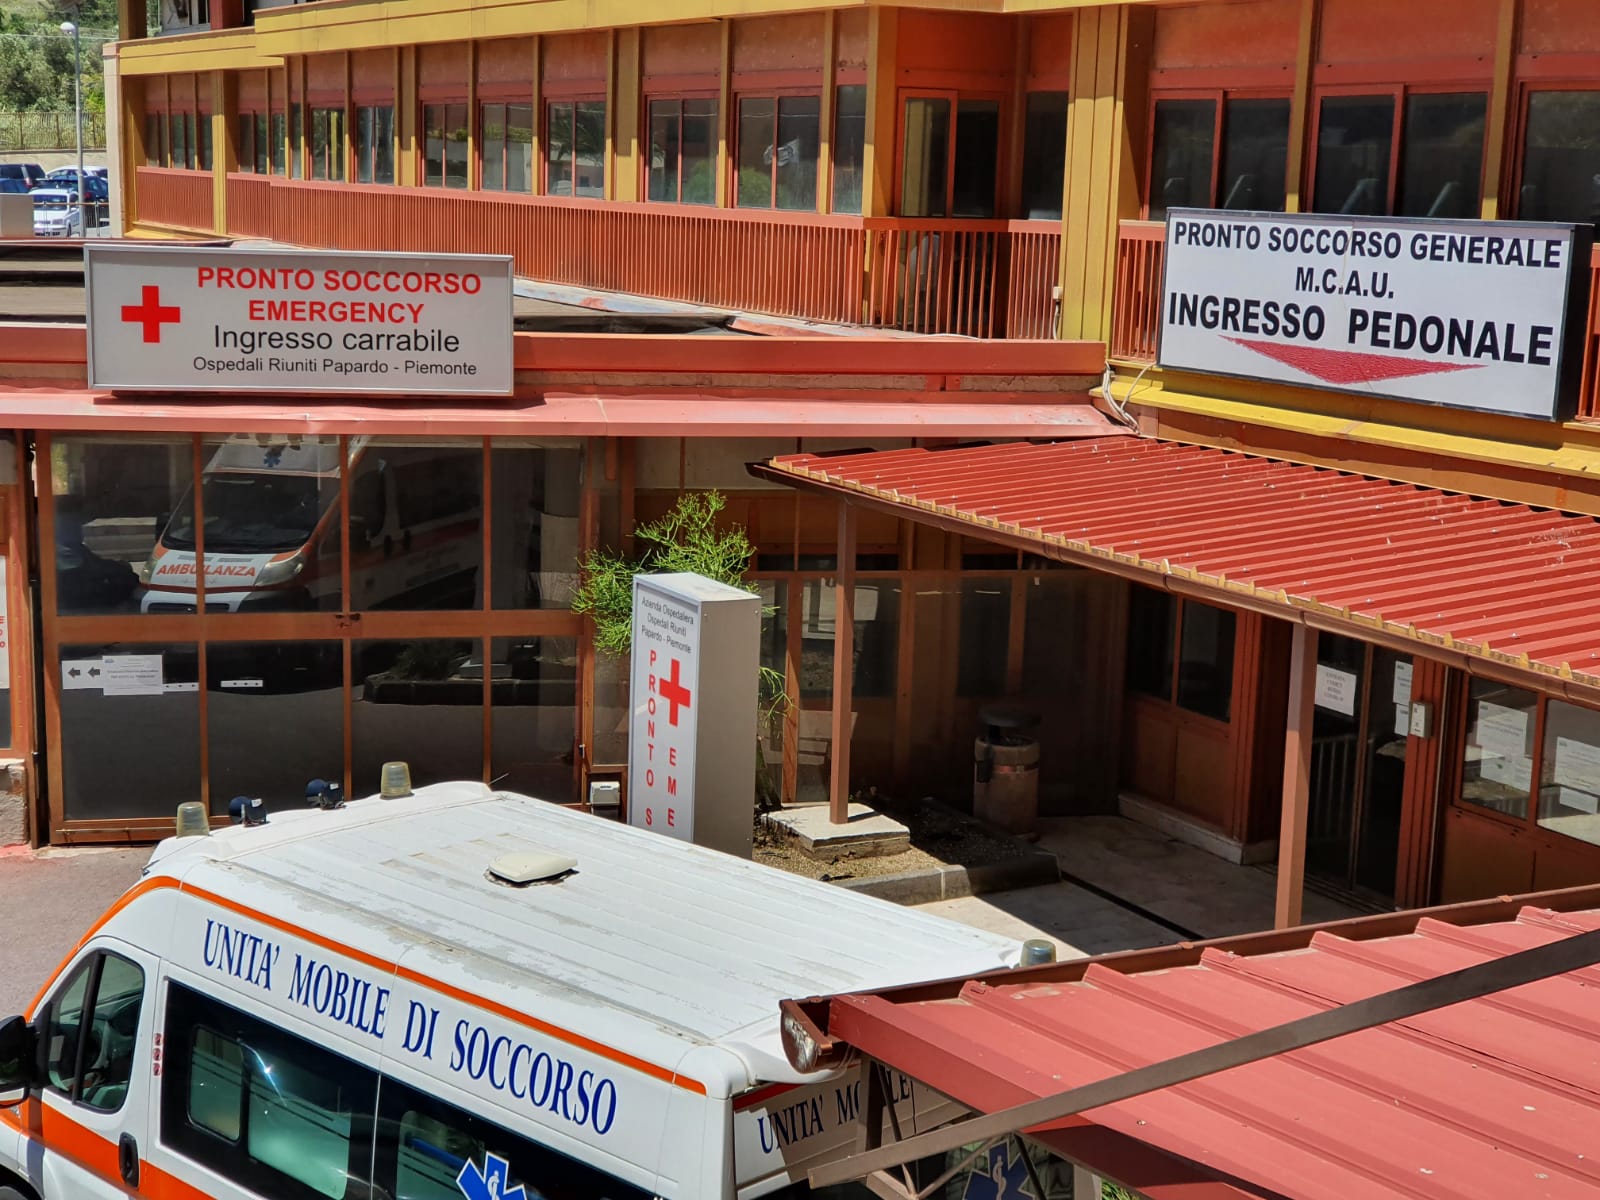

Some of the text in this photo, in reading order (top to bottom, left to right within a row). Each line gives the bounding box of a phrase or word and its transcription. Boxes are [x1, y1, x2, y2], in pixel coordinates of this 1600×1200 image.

[1174, 221, 1563, 268] PRONTO SOCCORSO GENERALE
[197, 266, 482, 295] PRONTO SOCCORSO
[1295, 266, 1394, 299] M.C.A.U.
[248, 299, 425, 324] EMERGENCY
[1168, 291, 1554, 366] INGRESSO PEDONALE
[214, 325, 460, 354] Ingresso carrabile
[193, 357, 263, 375] Ospedali
[269, 358, 317, 372] Riuniti
[323, 359, 389, 376] Papardo
[405, 360, 477, 375] Piemonte
[646, 649, 657, 788] PRONTO
[203, 918, 617, 1135] UNITA' MOBILE DI SOCCORSO
[757, 1094, 825, 1154] UNITA'
